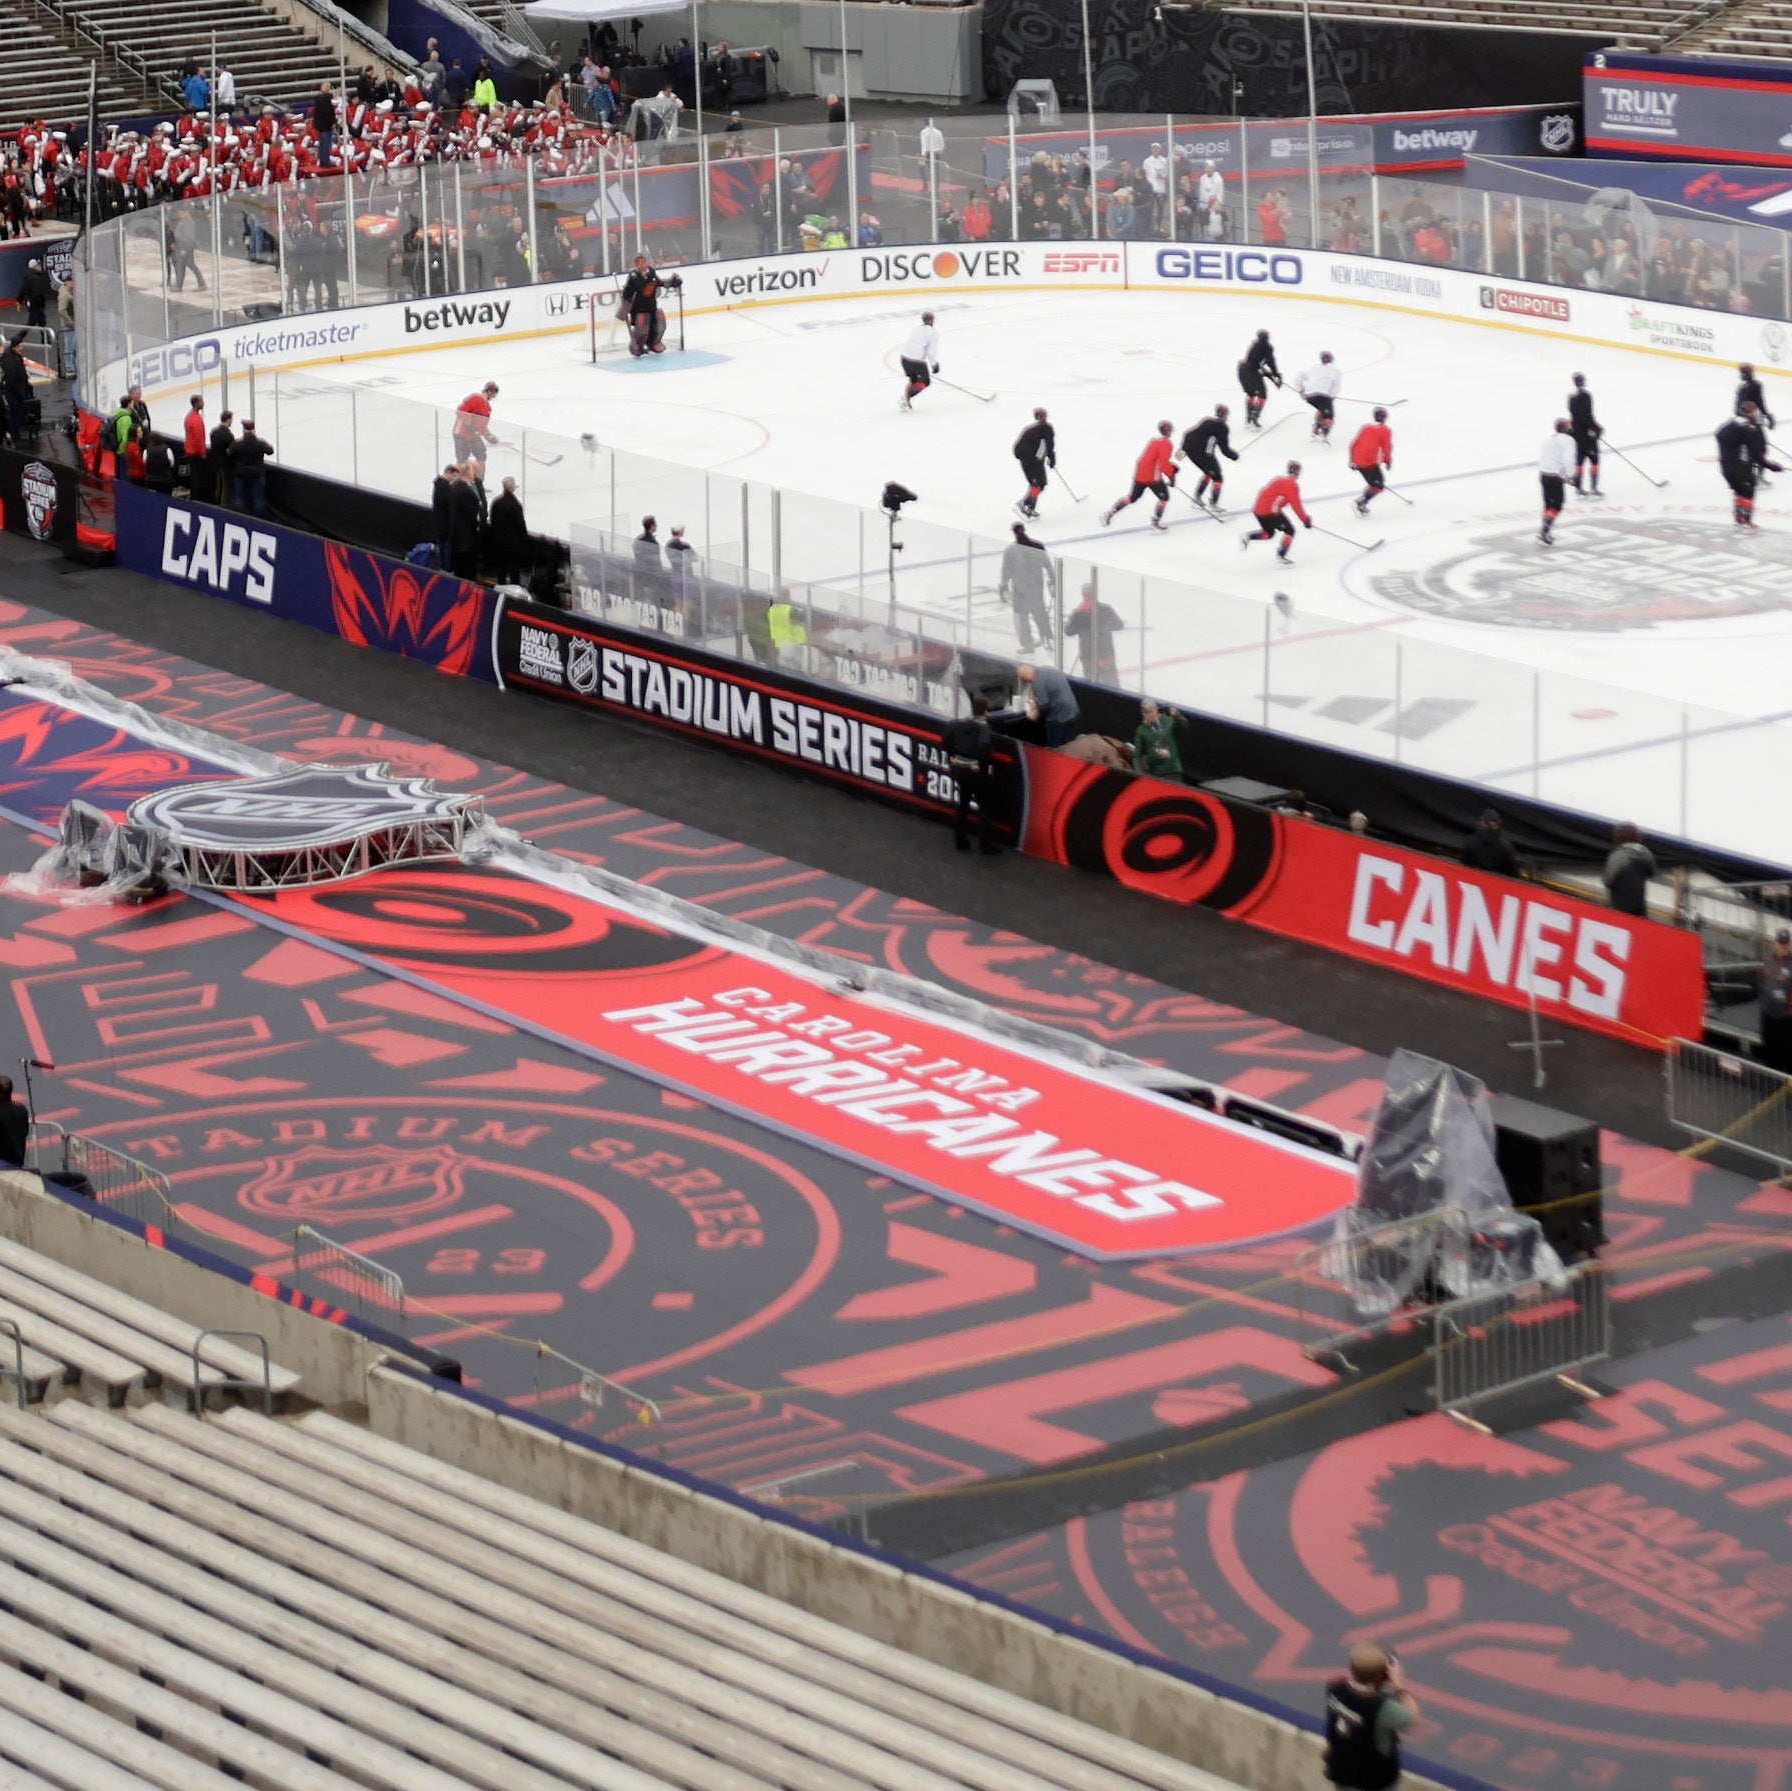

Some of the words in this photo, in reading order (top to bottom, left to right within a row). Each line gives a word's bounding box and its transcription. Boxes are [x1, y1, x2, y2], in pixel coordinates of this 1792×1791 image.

[1602, 87, 1678, 116] TRULY
[1393, 127, 1478, 152] betway
[862, 251, 1021, 282] DISCOVER
[1043, 253, 1119, 273] ESPN
[1155, 248, 1303, 285] GEICO
[1330, 265, 1352, 284] NEW
[715, 265, 818, 297] verizon
[404, 299, 511, 333] betway
[1498, 293, 1568, 317] CHIPOTLE
[234, 322, 361, 359] ticketmaster
[1630, 316, 1715, 339] DRAFTKINGS
[1650, 334, 1715, 352] SPORTSBOOK
[131, 338, 221, 388] GEICO
[23, 478, 57, 497] STADIUM
[161, 506, 277, 604] CAPS
[520, 625, 548, 646] NAVY
[520, 640, 563, 666] FEDERAL
[571, 653, 593, 681] NHL
[519, 659, 540, 677] Credit
[540, 665, 563, 684] Union
[602, 647, 764, 744] STADIUM
[770, 697, 914, 792] SERIES
[1348, 852, 1632, 1020] CANES
[711, 986, 1045, 1110] CAROLINA
[602, 997, 1225, 1222] HURRICANES
[287, 1159, 431, 1205] NHL
[570, 1138, 765, 1252] SERIES
[1569, 1483, 1769, 1568] NAVY
[1499, 1494, 1787, 1630] FEDERAL
[1437, 1522, 1581, 1596] Credit
[1568, 1584, 1706, 1654] Union
